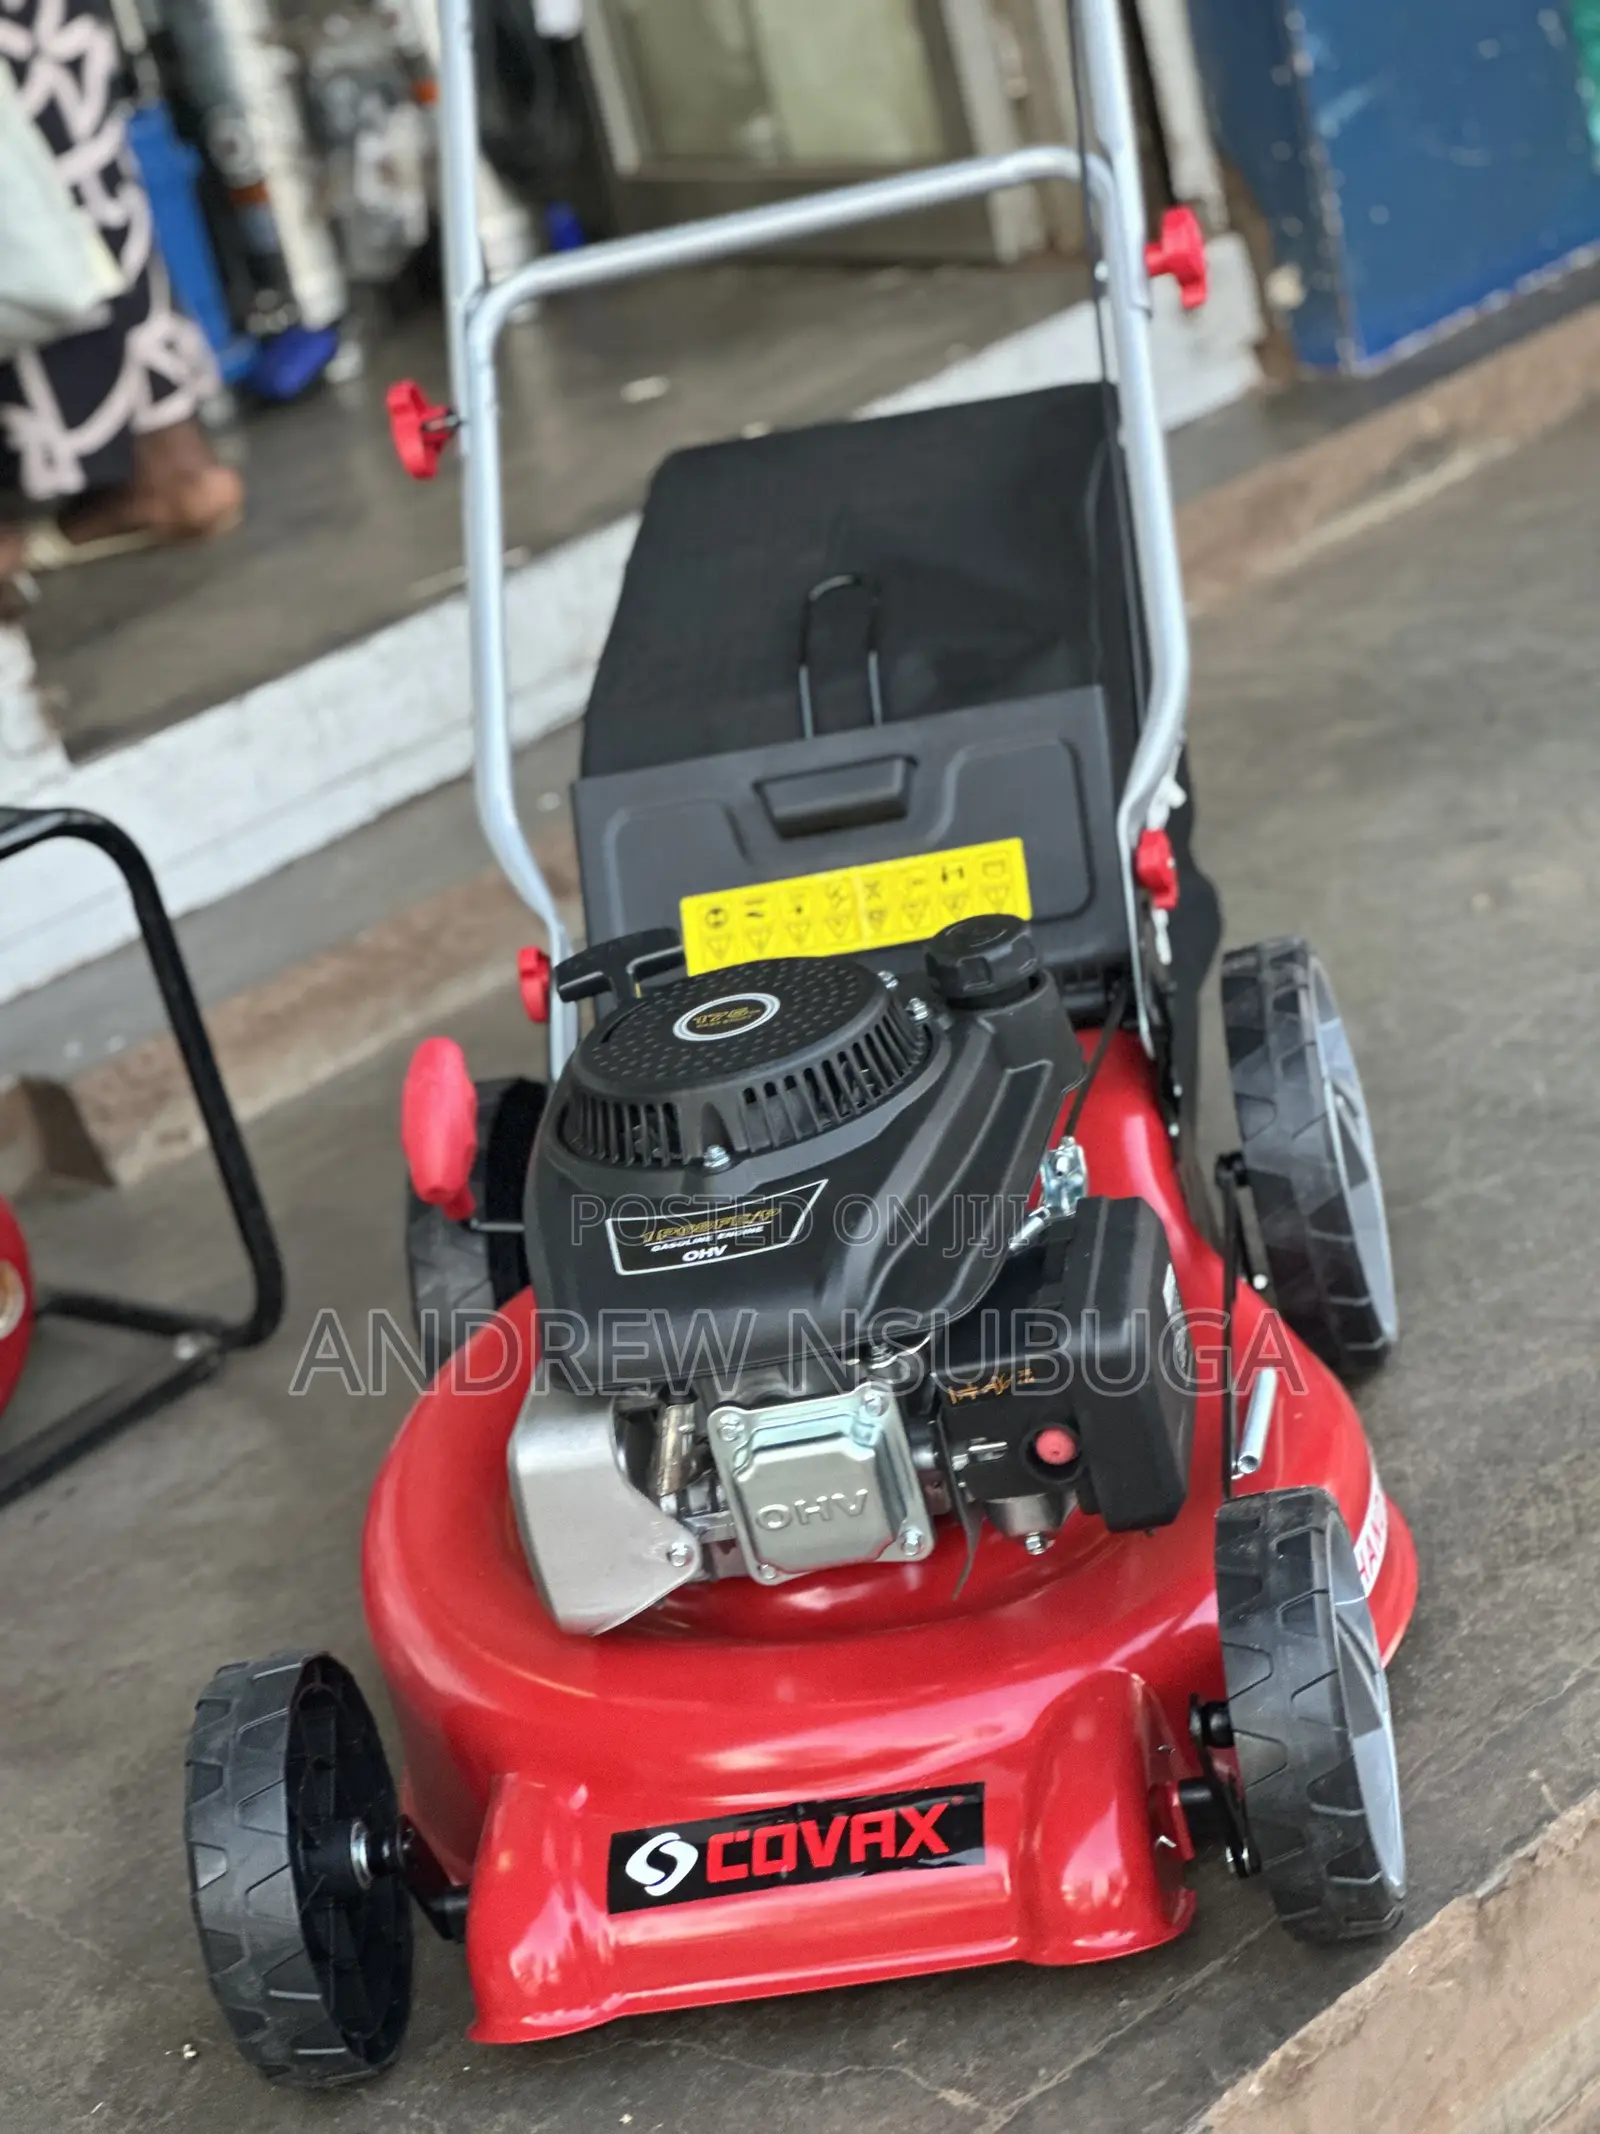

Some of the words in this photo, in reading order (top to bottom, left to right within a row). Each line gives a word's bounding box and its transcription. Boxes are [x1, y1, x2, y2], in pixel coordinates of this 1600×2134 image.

[650, 1235, 713, 1252] GASOLINE
[717, 1225, 765, 1240] ENGINE
[682, 1244, 729, 1262] OHV
[755, 1488, 869, 1531] OHV
[706, 1802, 950, 1884] COVAX
